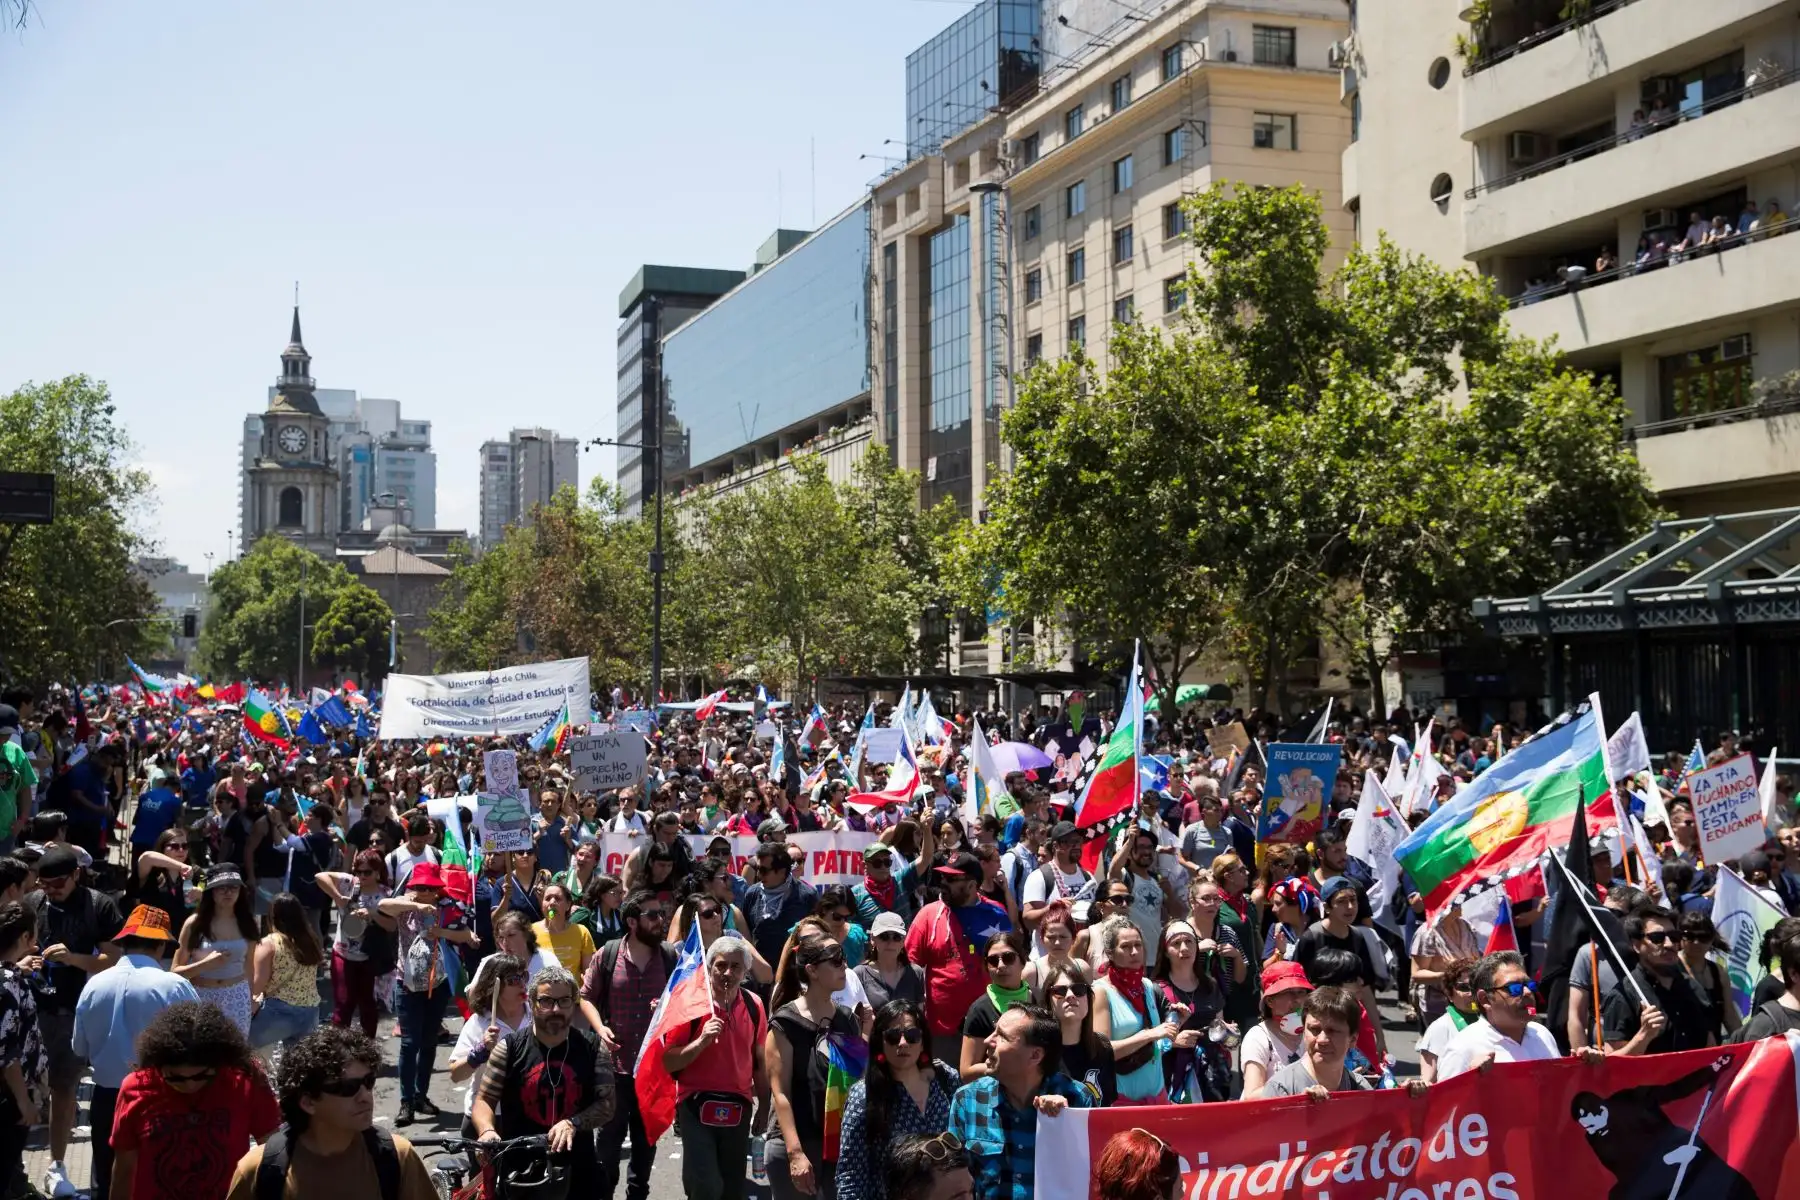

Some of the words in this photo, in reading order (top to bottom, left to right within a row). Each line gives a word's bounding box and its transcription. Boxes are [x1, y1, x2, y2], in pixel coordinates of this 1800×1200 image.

[501, 674, 513, 682] de
[514, 672, 537, 681] Chile
[472, 696, 486, 706] de
[487, 691, 524, 704] Calidad
[526, 692, 533, 700] e
[468, 717, 480, 726] de
[573, 738, 621, 752] CULTURA
[592, 752, 606, 761] UN
[577, 761, 628, 776] DERECHO
[592, 772, 632, 785] HUMANO
[1695, 780, 1711, 793] LA
[1697, 775, 1754, 806] LUCHANDO
[1428, 1105, 1489, 1163] de
